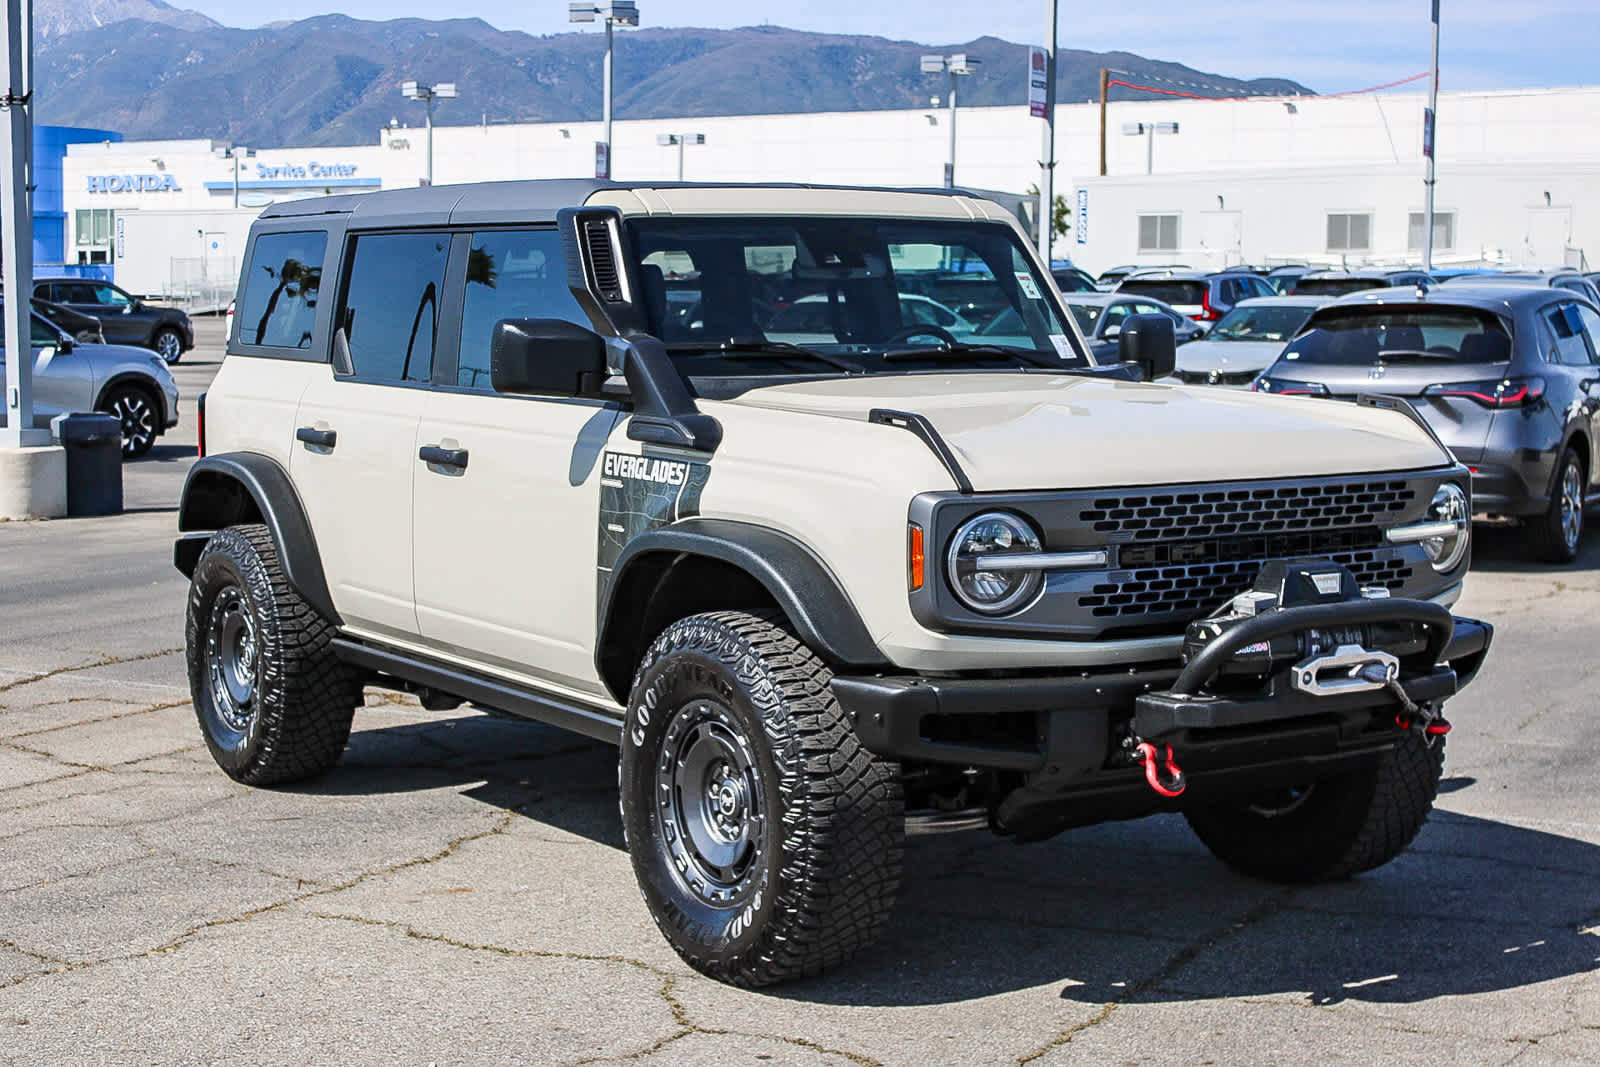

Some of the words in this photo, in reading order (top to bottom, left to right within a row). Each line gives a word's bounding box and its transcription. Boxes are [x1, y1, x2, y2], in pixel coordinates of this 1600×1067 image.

[256, 162, 306, 179] Service
[308, 161, 358, 178] Center
[86, 174, 182, 194] HONDA
[604, 453, 685, 486] EVERGLADES
